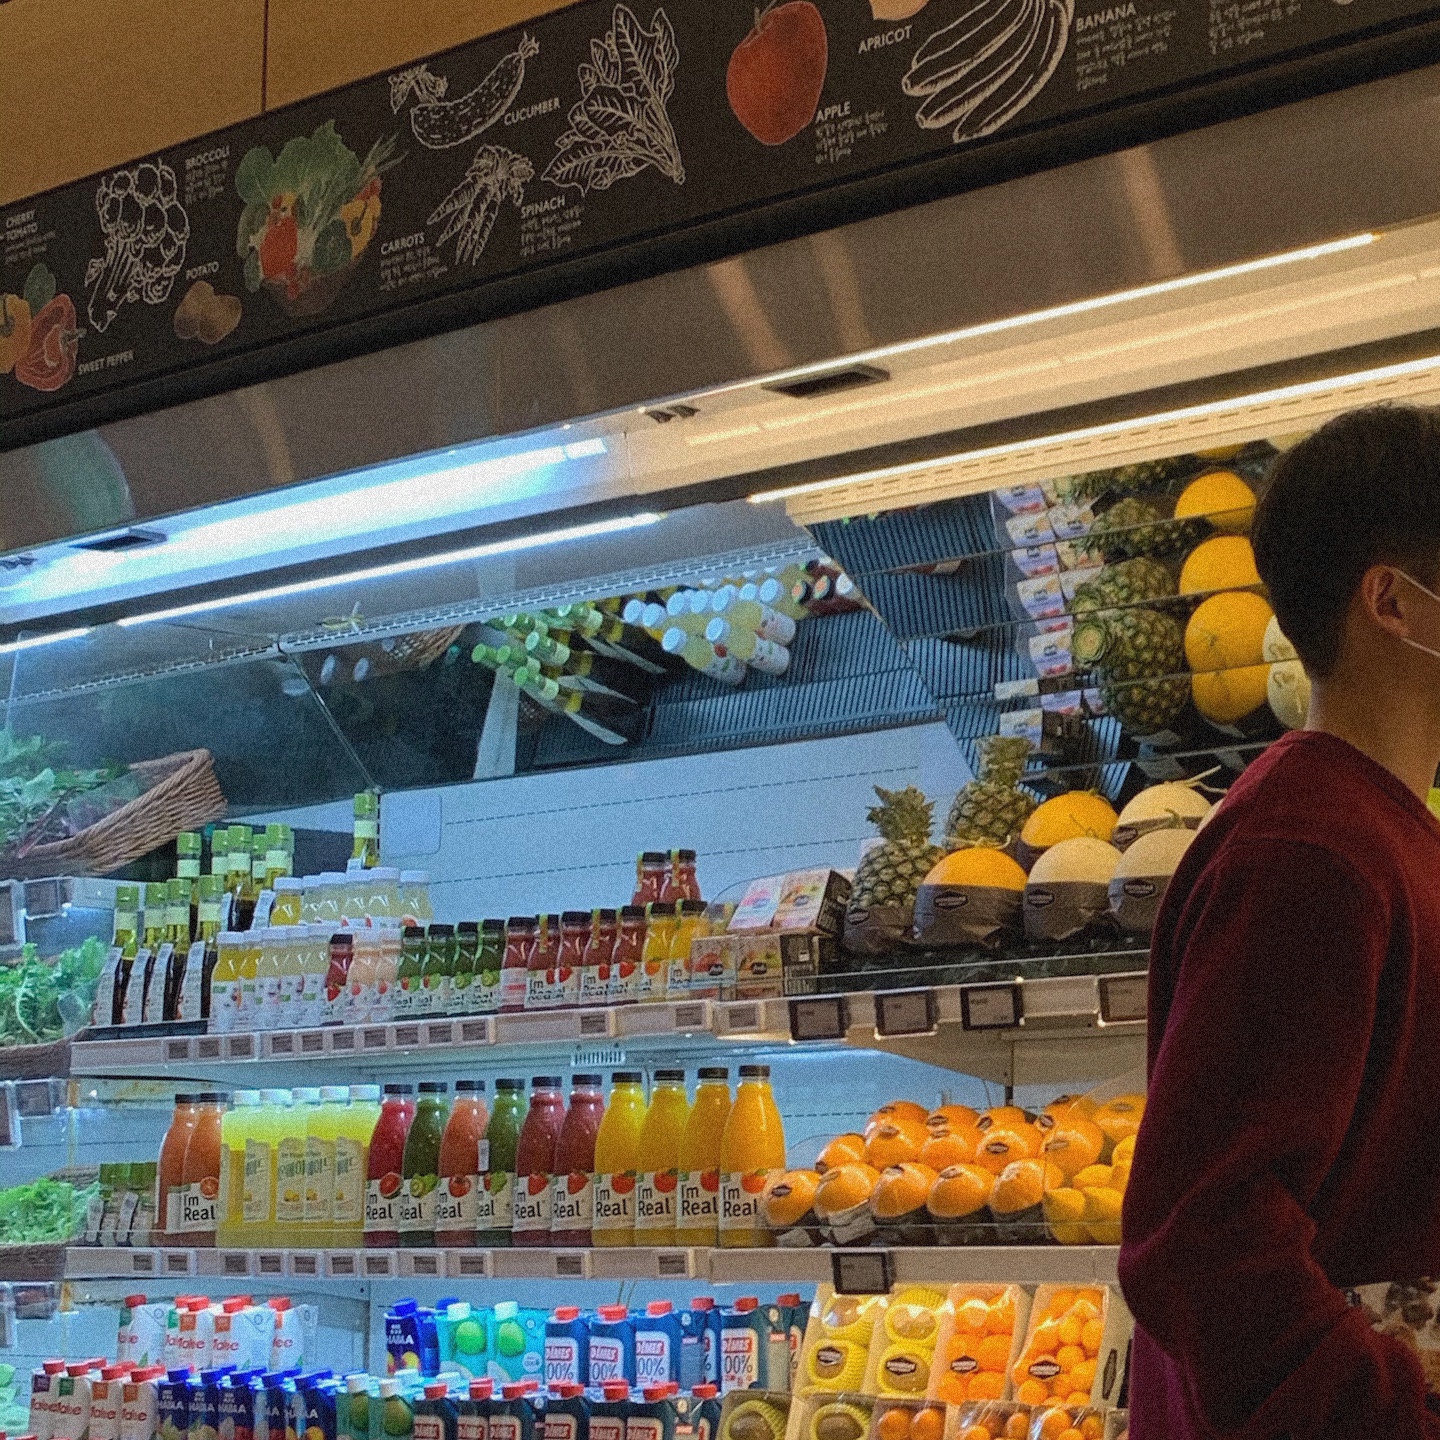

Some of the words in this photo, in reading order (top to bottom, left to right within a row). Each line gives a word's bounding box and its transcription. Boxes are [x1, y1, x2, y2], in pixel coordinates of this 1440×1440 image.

[1076, 2, 1136, 32] BANANA
[858, 25, 912, 53] APRICOT
[503, 98, 560, 126] CUCUMBER
[815, 101, 851, 124] APPLE
[185, 146, 230, 168] BROCCOLI
[521, 196, 566, 219] SPINACH
[381, 233, 425, 255] CARROTS
[185, 261, 220, 280] POTATO
[78, 357, 105, 375] SWEET
[106, 350, 134, 371] PEPPER
[184, 1204, 216, 1222] Real
[366, 1201, 393, 1220] Real
[478, 1200, 495, 1218] eal
[553, 1199, 582, 1218] Real
[596, 1198, 629, 1218] Real
[638, 1197, 671, 1217] Real
[681, 1196, 718, 1216] Real
[722, 1198, 758, 1218] Real
